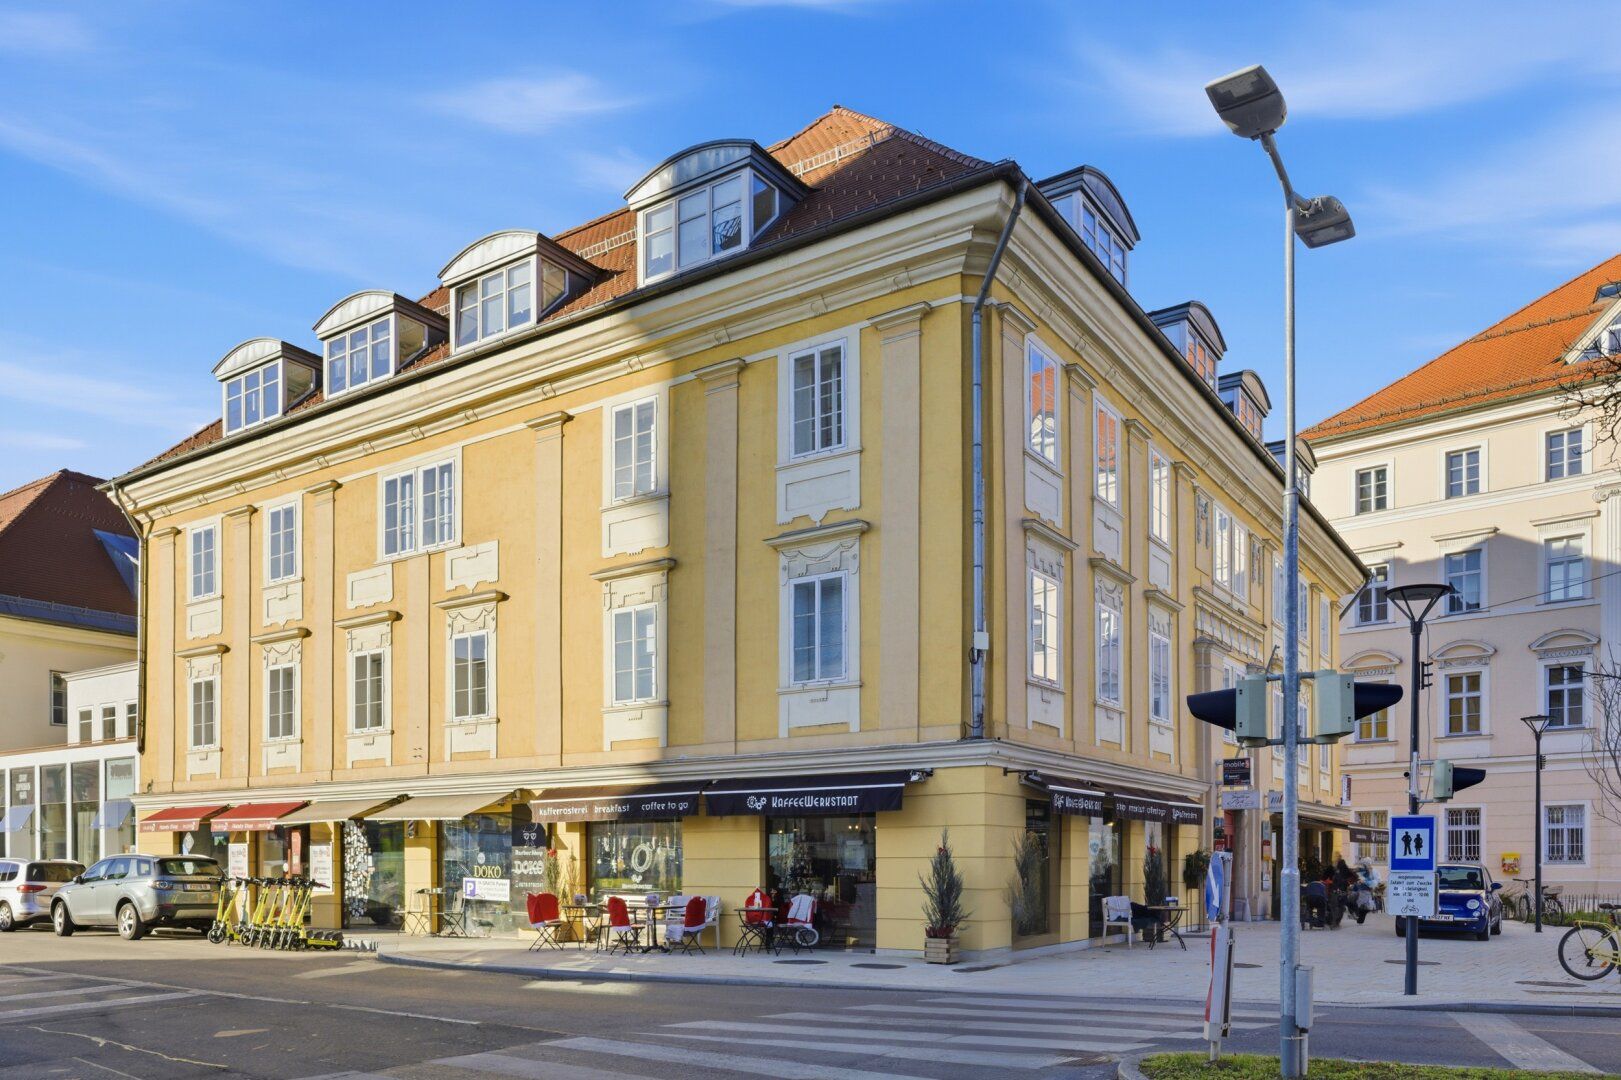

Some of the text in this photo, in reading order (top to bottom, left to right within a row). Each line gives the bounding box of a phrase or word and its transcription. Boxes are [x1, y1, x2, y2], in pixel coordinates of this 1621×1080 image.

[594, 804, 630, 814] breakfast
[641, 801, 689, 811] coffee to go
[473, 865, 502, 879] DOKO
